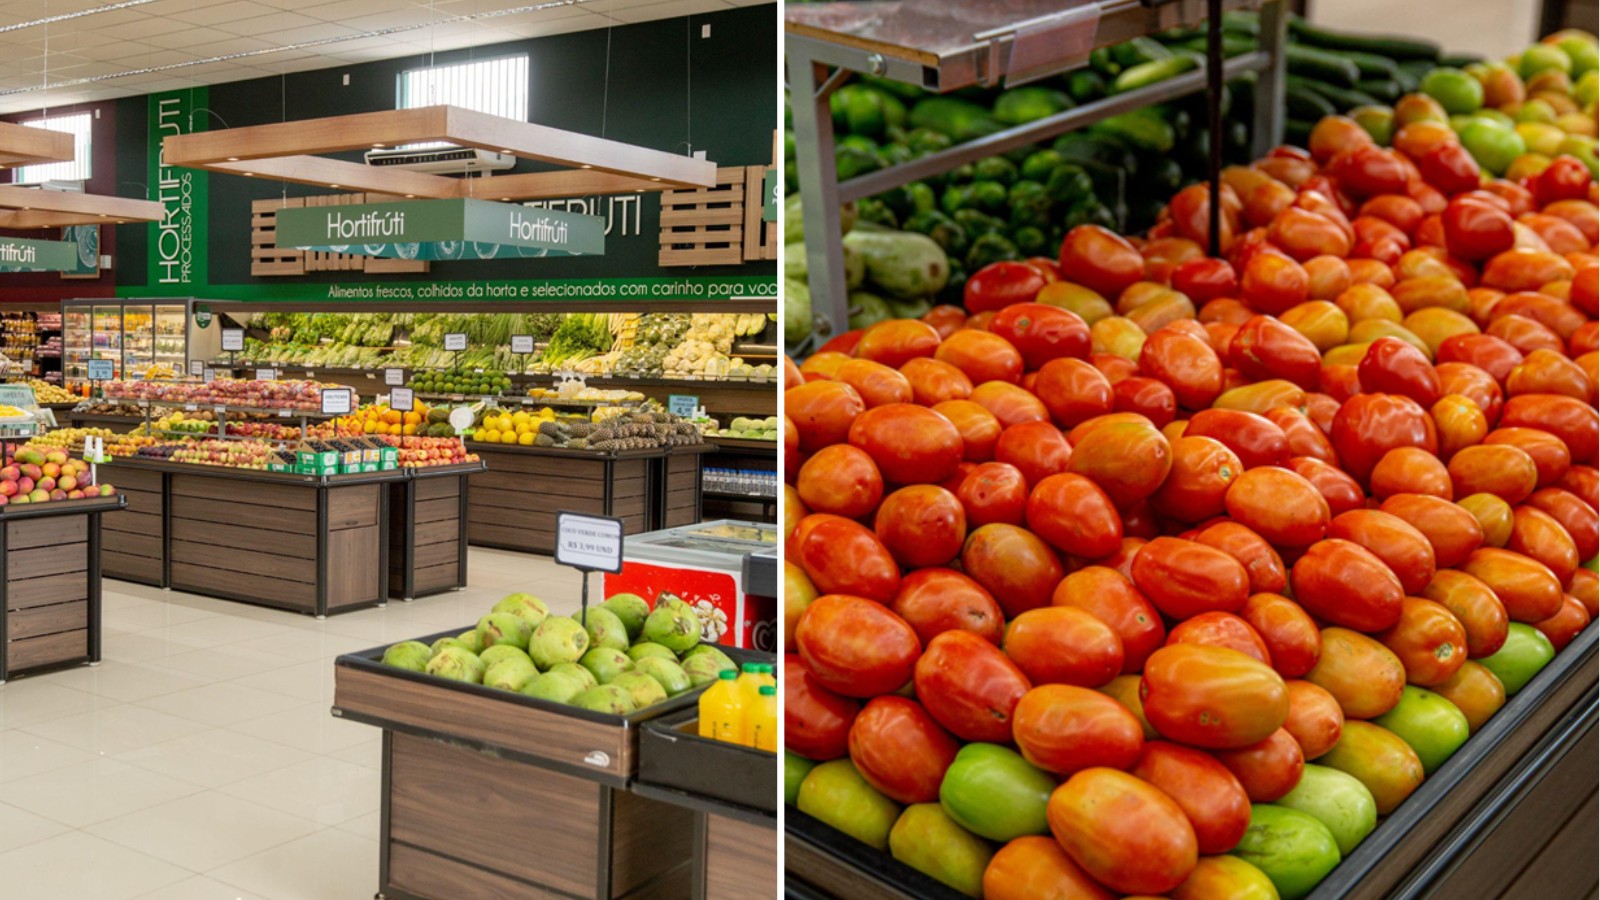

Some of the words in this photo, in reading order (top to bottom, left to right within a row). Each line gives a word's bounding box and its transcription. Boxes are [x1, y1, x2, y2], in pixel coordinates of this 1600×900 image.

[159, 98, 181, 283] HORTIFUTI
[181, 172, 192, 283] PROCESSADOS
[327, 211, 405, 239] Hortifrúti
[509, 211, 568, 244] Hortifrúti
[328, 285, 374, 298] Alimentos
[376, 285, 414, 299] frescos,
[417, 284, 463, 298] colhidos
[466, 283, 483, 297] da
[486, 283, 517, 297] horta
[520, 286, 529, 297] e
[532, 281, 616, 297] selecionados
[620, 284, 648, 295] com
[651, 280, 704, 295] carinho
[708, 283, 744, 298] para
[568, 541, 578, 549] R$
[597, 545, 613, 554] UND
